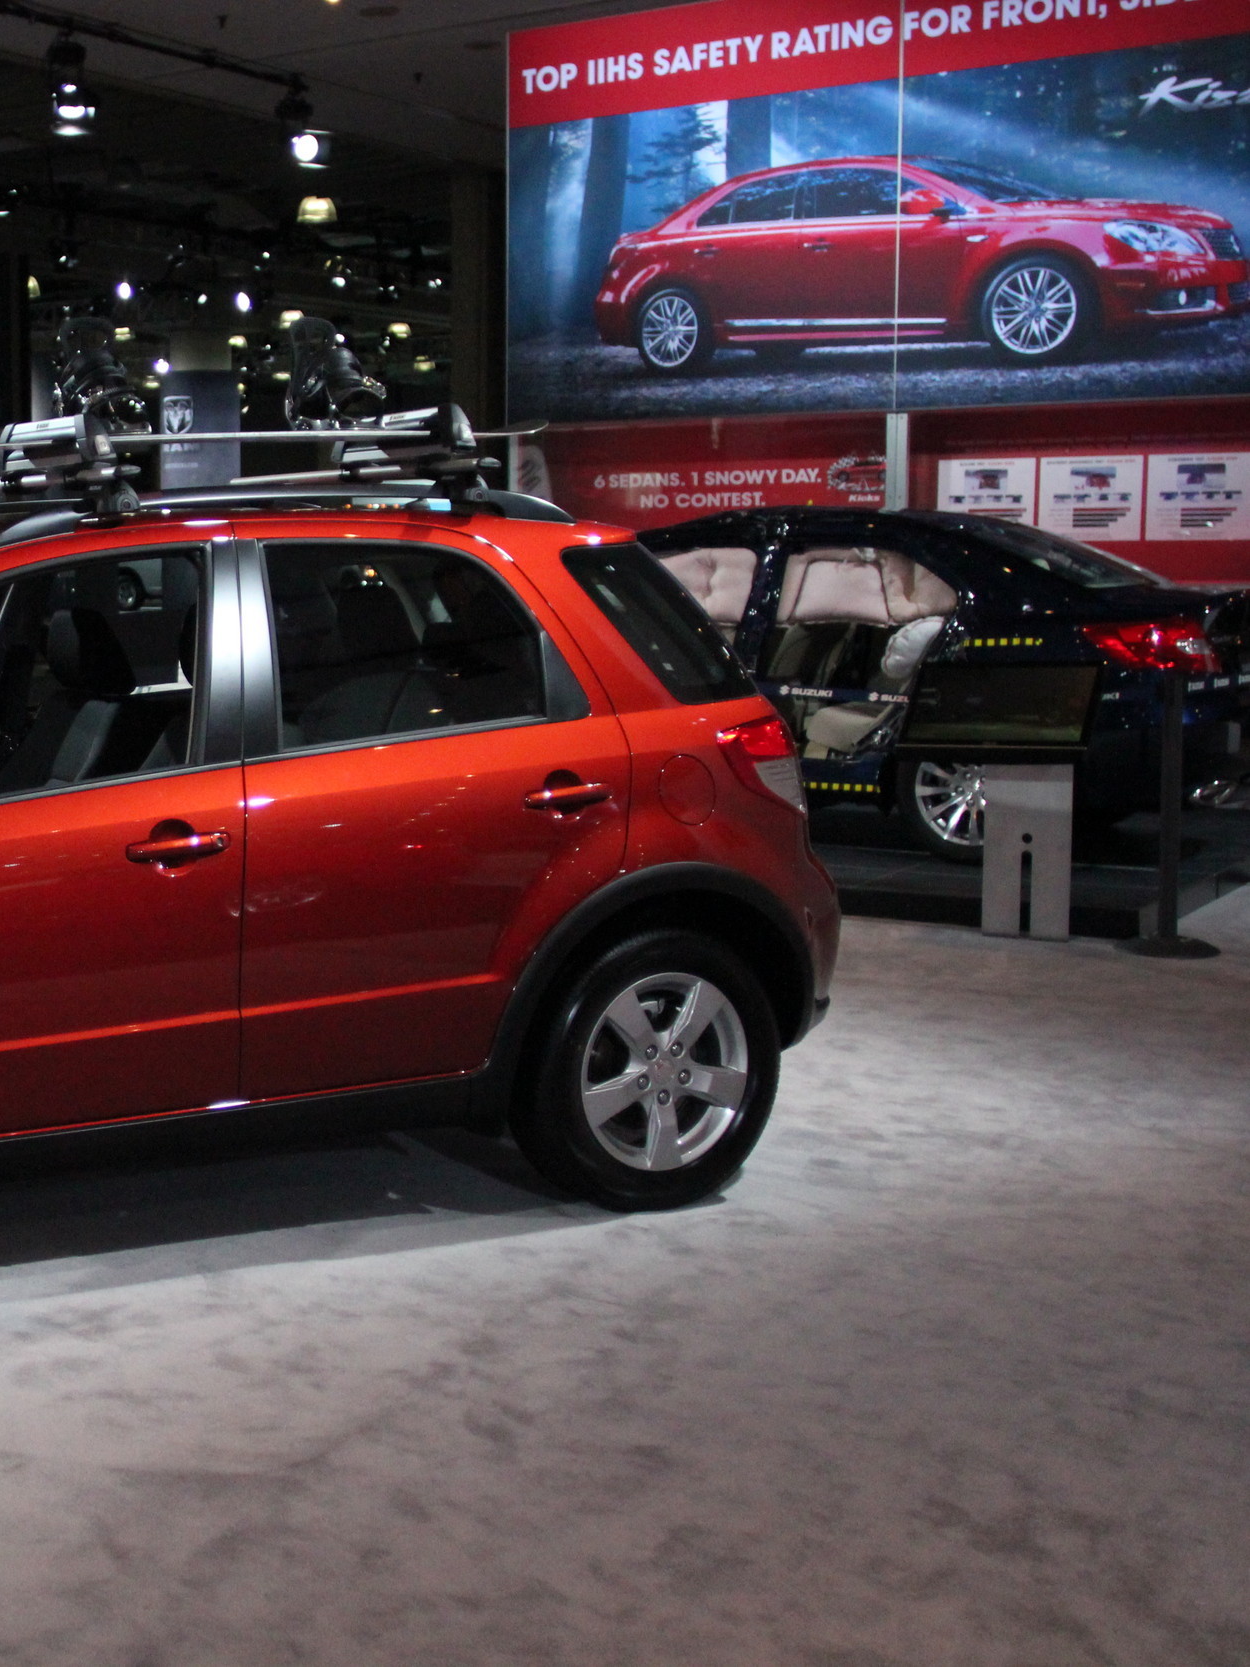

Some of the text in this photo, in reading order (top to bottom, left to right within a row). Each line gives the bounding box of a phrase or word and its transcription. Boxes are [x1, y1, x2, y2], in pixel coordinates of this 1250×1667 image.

[522, 63, 578, 94] TOP
[587, 52, 644, 86] IIHS
[653, 34, 764, 77] SAFETY
[770, 15, 893, 59] RATING
[903, 8, 972, 41] FOR
[594, 474, 605, 489] 6
[608, 472, 685, 489] SEDANS.
[691, 471, 698, 487] 1
[704, 468, 780, 486] SNOWY
[781, 468, 822, 485] DAY.
[639, 491, 766, 509] NO CONTEST.
[791, 687, 909, 703] SUZUKI SUZ
